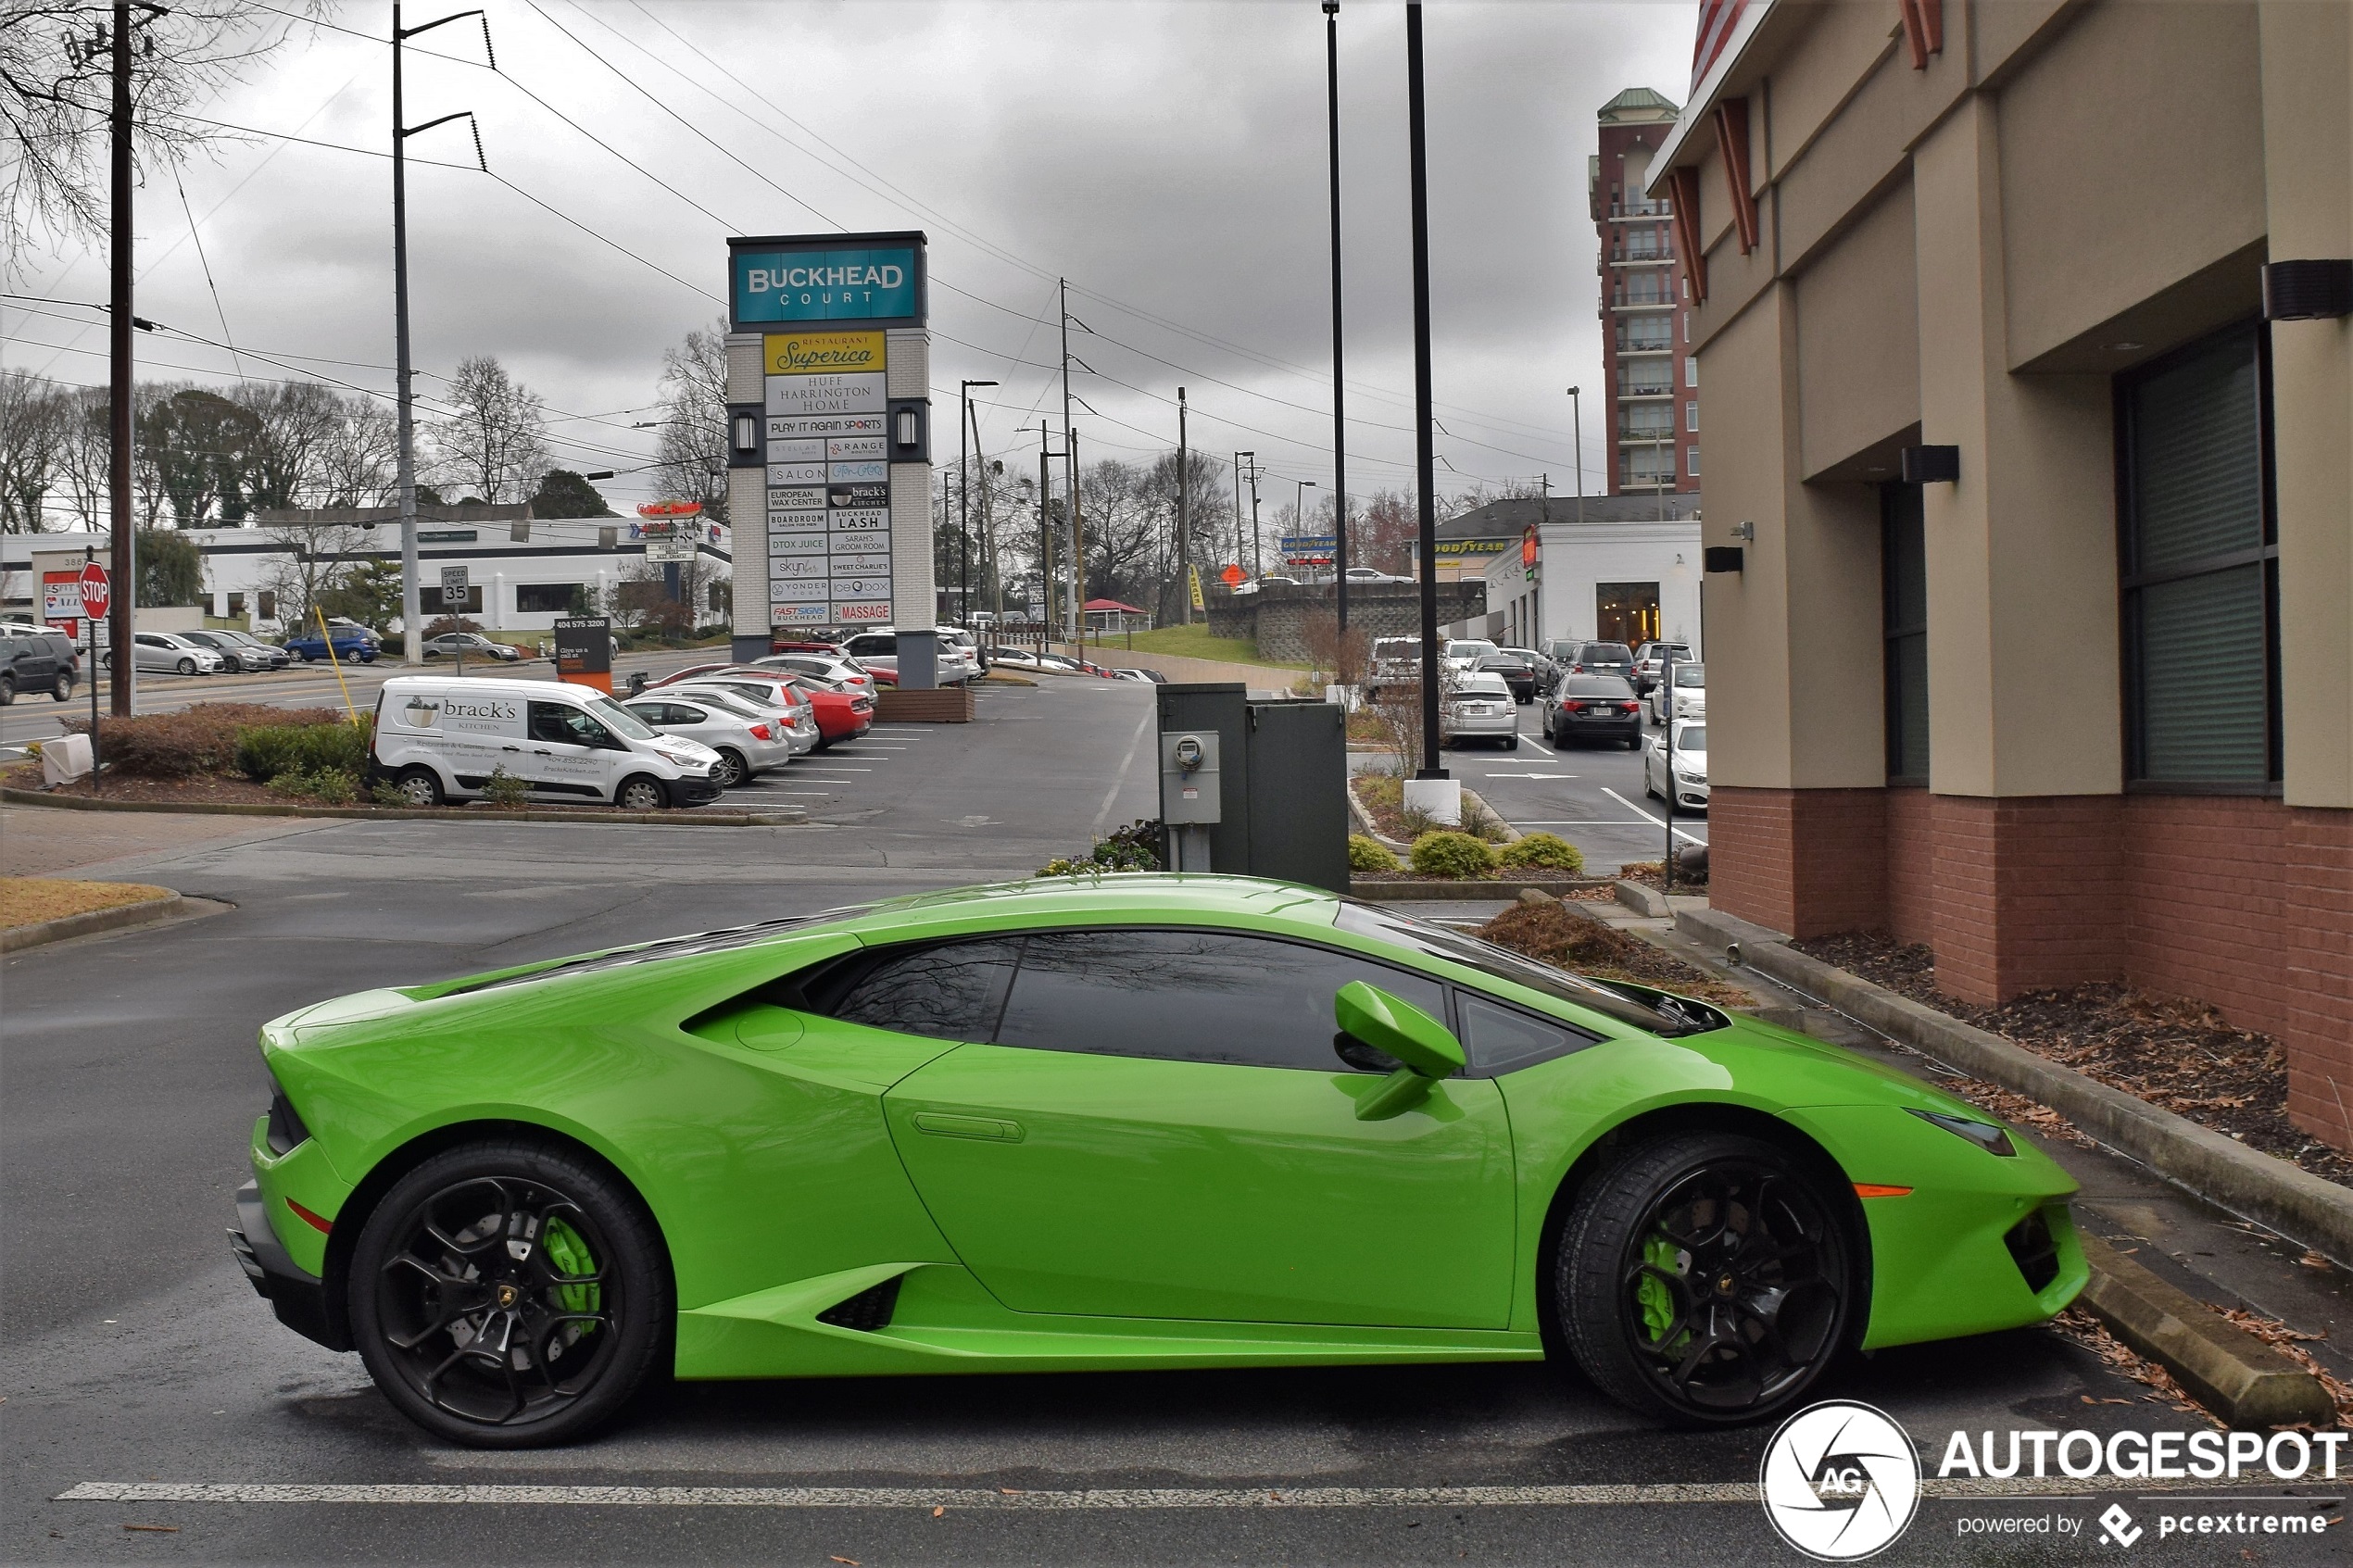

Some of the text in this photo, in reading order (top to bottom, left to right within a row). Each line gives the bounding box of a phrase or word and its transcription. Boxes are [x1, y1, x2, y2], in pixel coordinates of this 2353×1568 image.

[749, 265, 903, 293] BUCKHEAD
[780, 292, 872, 306] COURT
[802, 337, 868, 345] RESTAURANT
[777, 341, 874, 370] Superica
[808, 376, 843, 386] HUFF
[780, 386, 871, 399] HARRINGTON
[803, 399, 849, 411] HOME
[771, 419, 882, 433] PLAY IT AGAIN SPORTS
[844, 442, 885, 450] RANGE
[776, 469, 825, 480] SALON
[771, 490, 813, 499] EUROPEAN
[852, 486, 887, 497] brack's
[771, 498, 823, 507] WAX CENTER
[771, 514, 824, 523] BOARDROOM
[838, 517, 878, 529] LASH
[773, 539, 824, 549] DTOX JUICE
[845, 534, 874, 543] SARAH'S
[835, 542, 886, 551] GROOM ROOM
[1435, 540, 1504, 554] OODYEAR
[444, 570, 466, 578] SPEED
[82, 580, 108, 603] STOP
[446, 585, 466, 600] 35
[774, 607, 826, 615] FASTSIGNS
[842, 605, 889, 620] MASSAGE
[587, 620, 605, 628] 3200
[445, 699, 516, 719] brack's
[459, 722, 500, 731] KITCHEN
